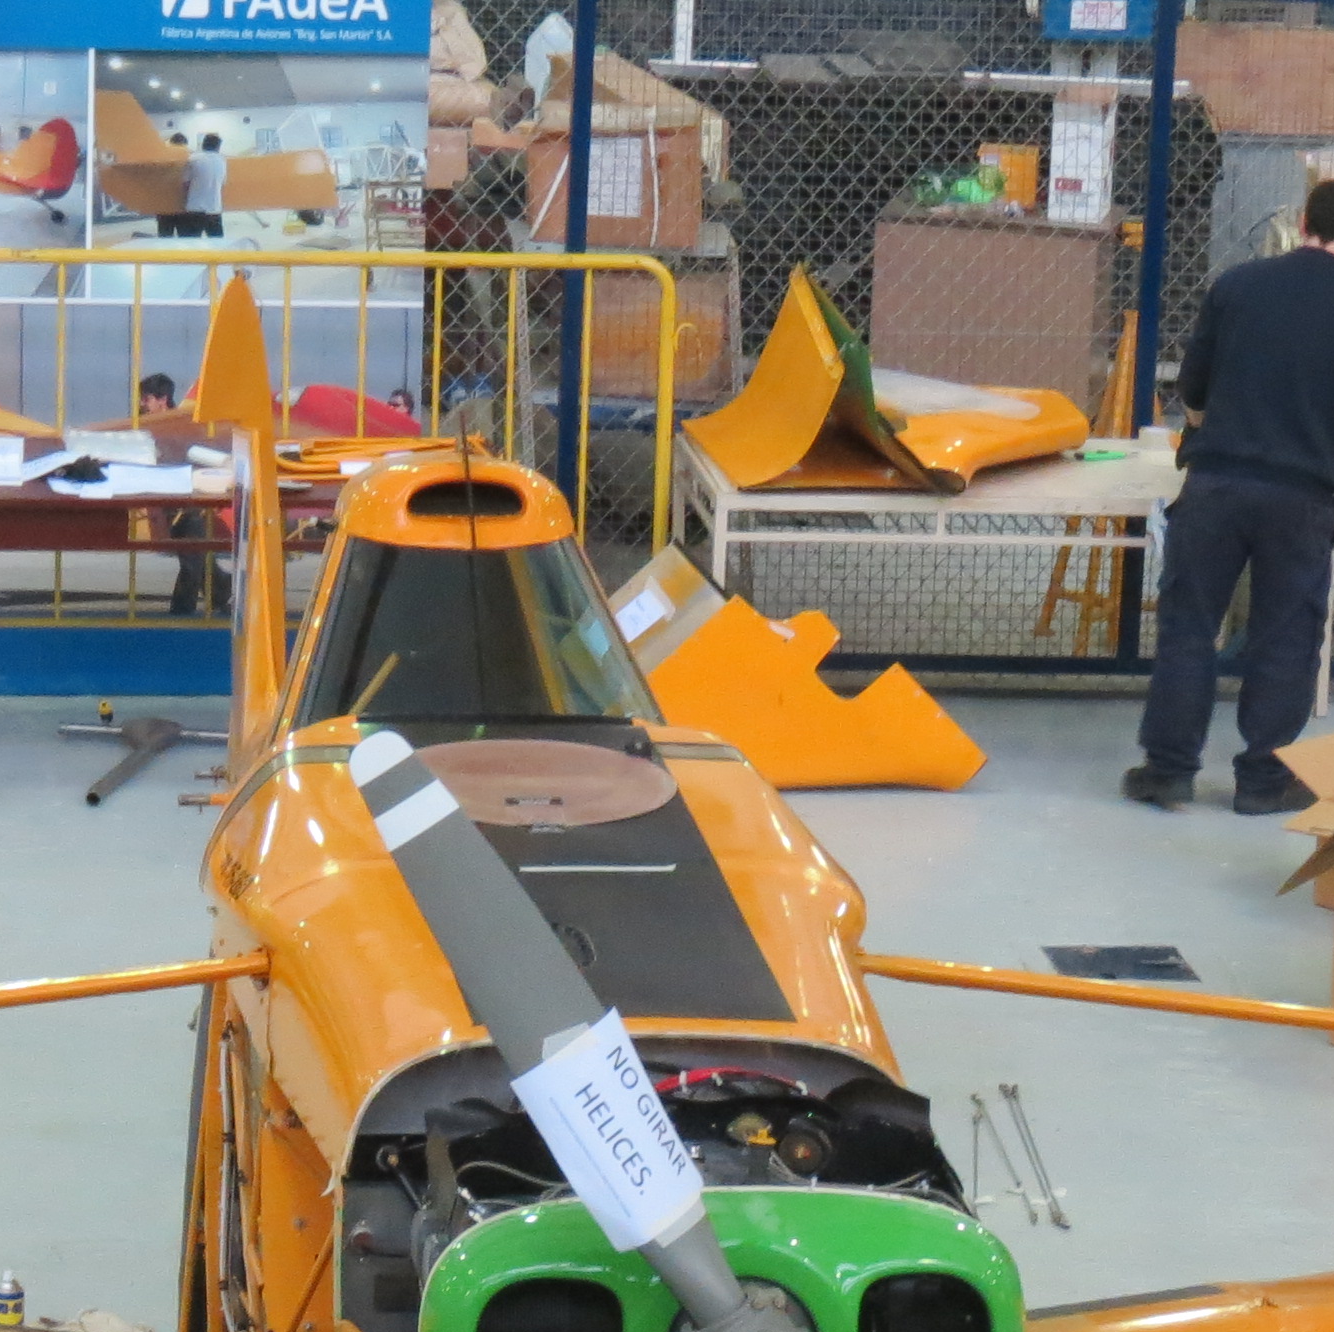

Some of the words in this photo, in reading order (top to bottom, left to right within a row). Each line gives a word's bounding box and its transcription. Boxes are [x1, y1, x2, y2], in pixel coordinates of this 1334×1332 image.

[574, 1082, 652, 1196] HELICES.
[606, 1046, 639, 1090] NO
[637, 1093, 687, 1176] GIRAR
